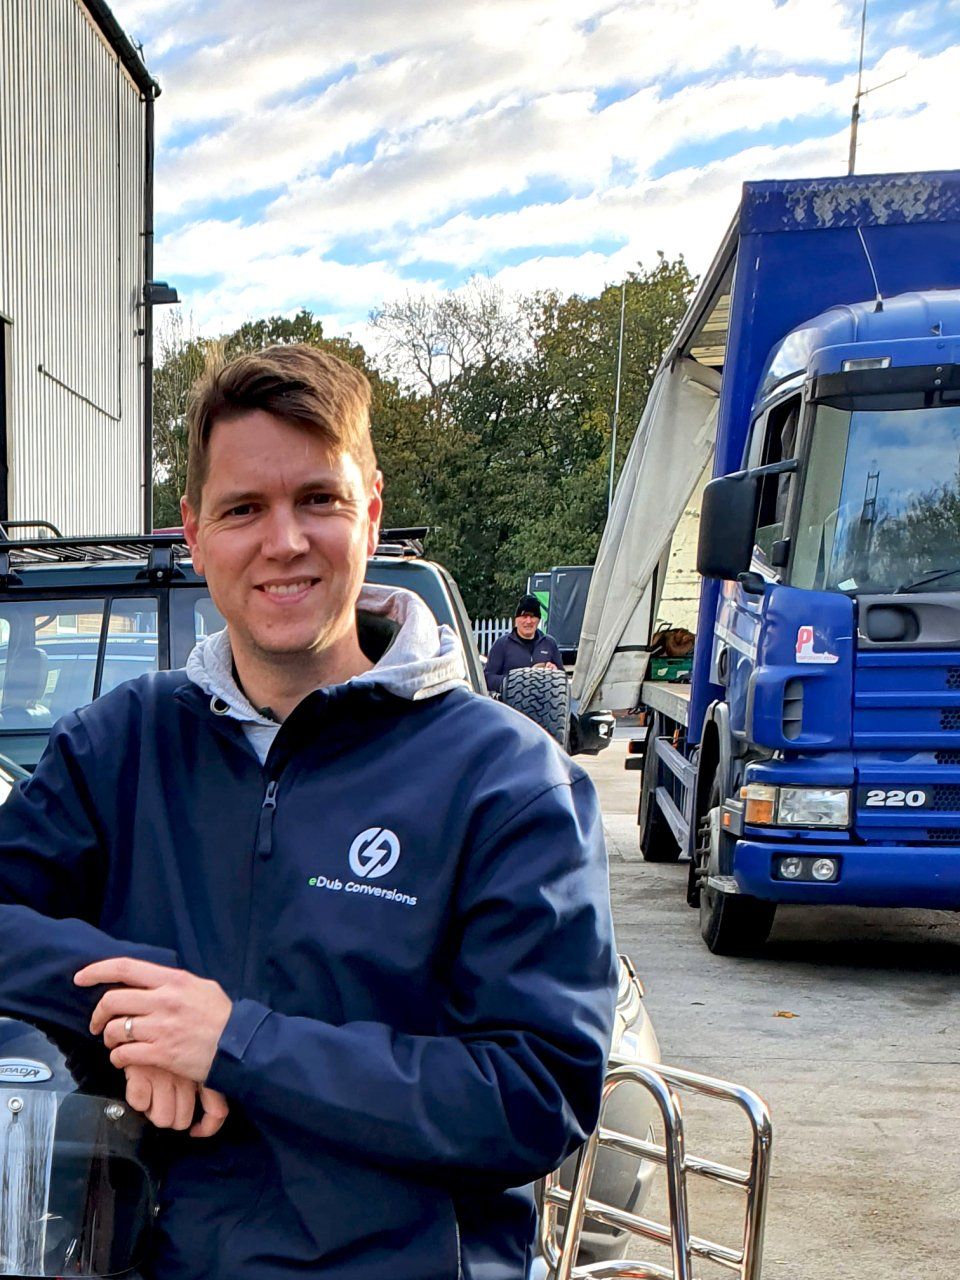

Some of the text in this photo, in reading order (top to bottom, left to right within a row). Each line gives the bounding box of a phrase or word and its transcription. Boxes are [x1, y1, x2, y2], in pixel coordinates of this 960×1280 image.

[866, 790, 926, 807] 220
[308, 876, 418, 906] eDub Conversions
